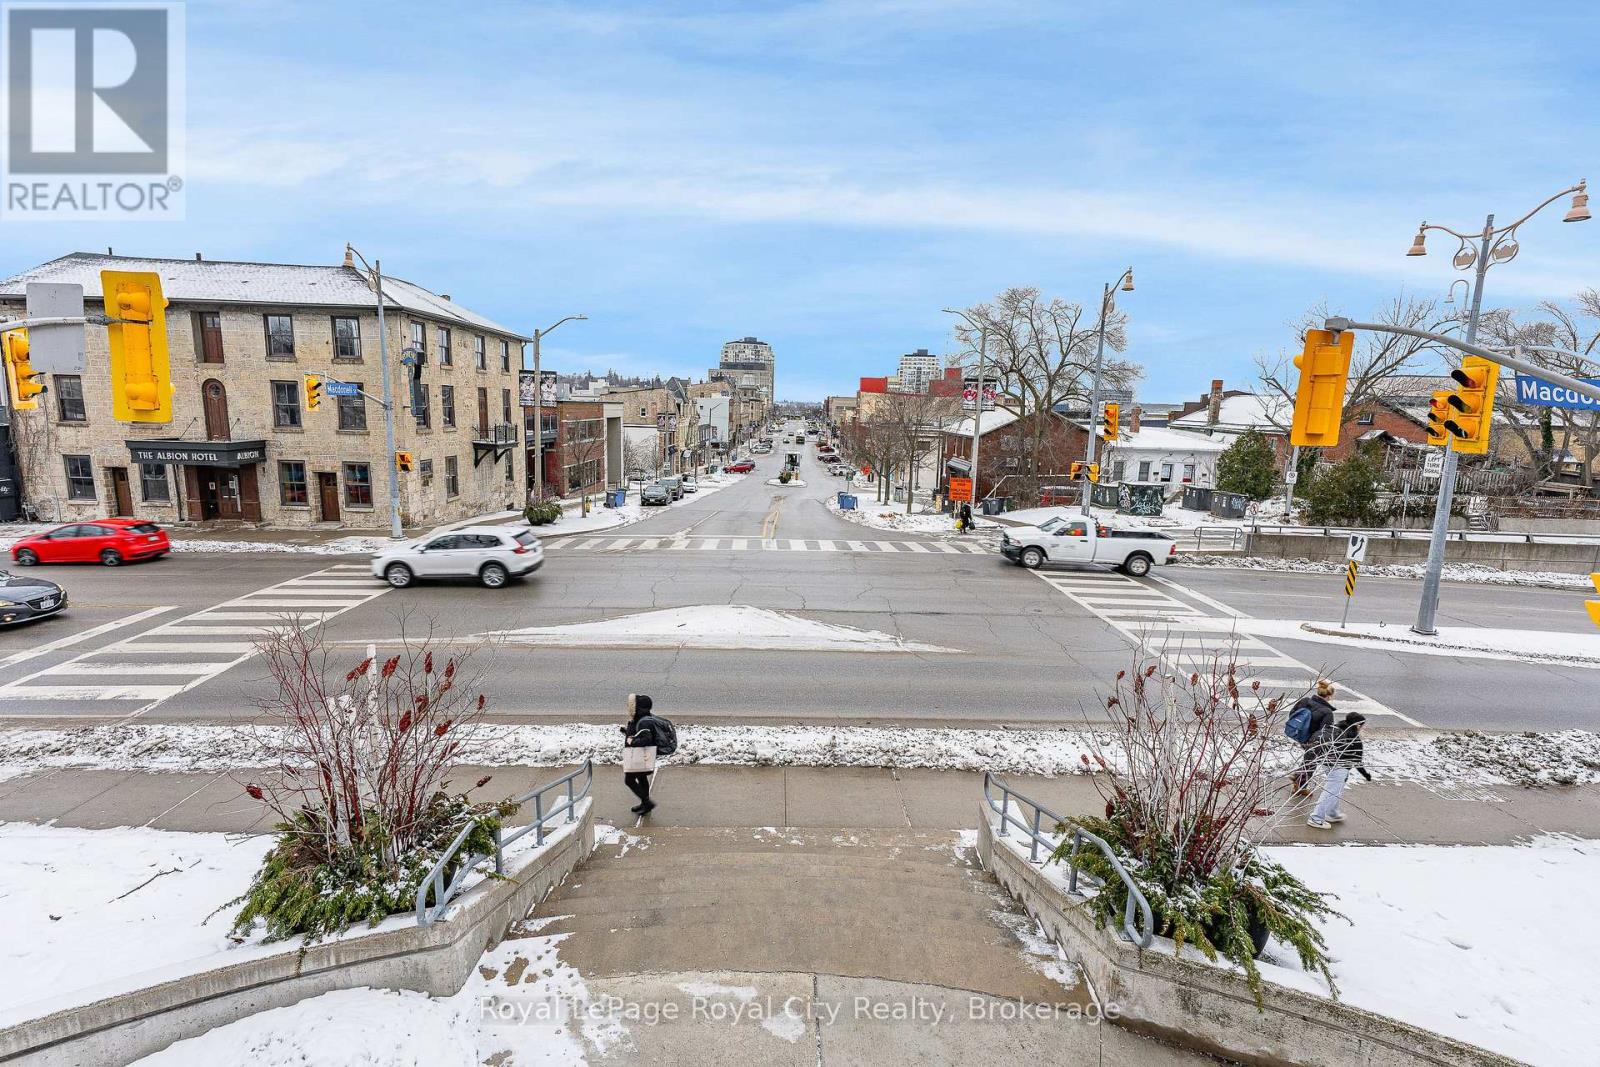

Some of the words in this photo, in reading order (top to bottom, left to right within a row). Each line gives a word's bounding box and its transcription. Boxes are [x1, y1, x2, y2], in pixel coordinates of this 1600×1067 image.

[138, 451, 153, 460] THE
[157, 452, 188, 460] ALBION
[191, 452, 218, 461] HOTEL
[236, 451, 259, 460] ALBION
